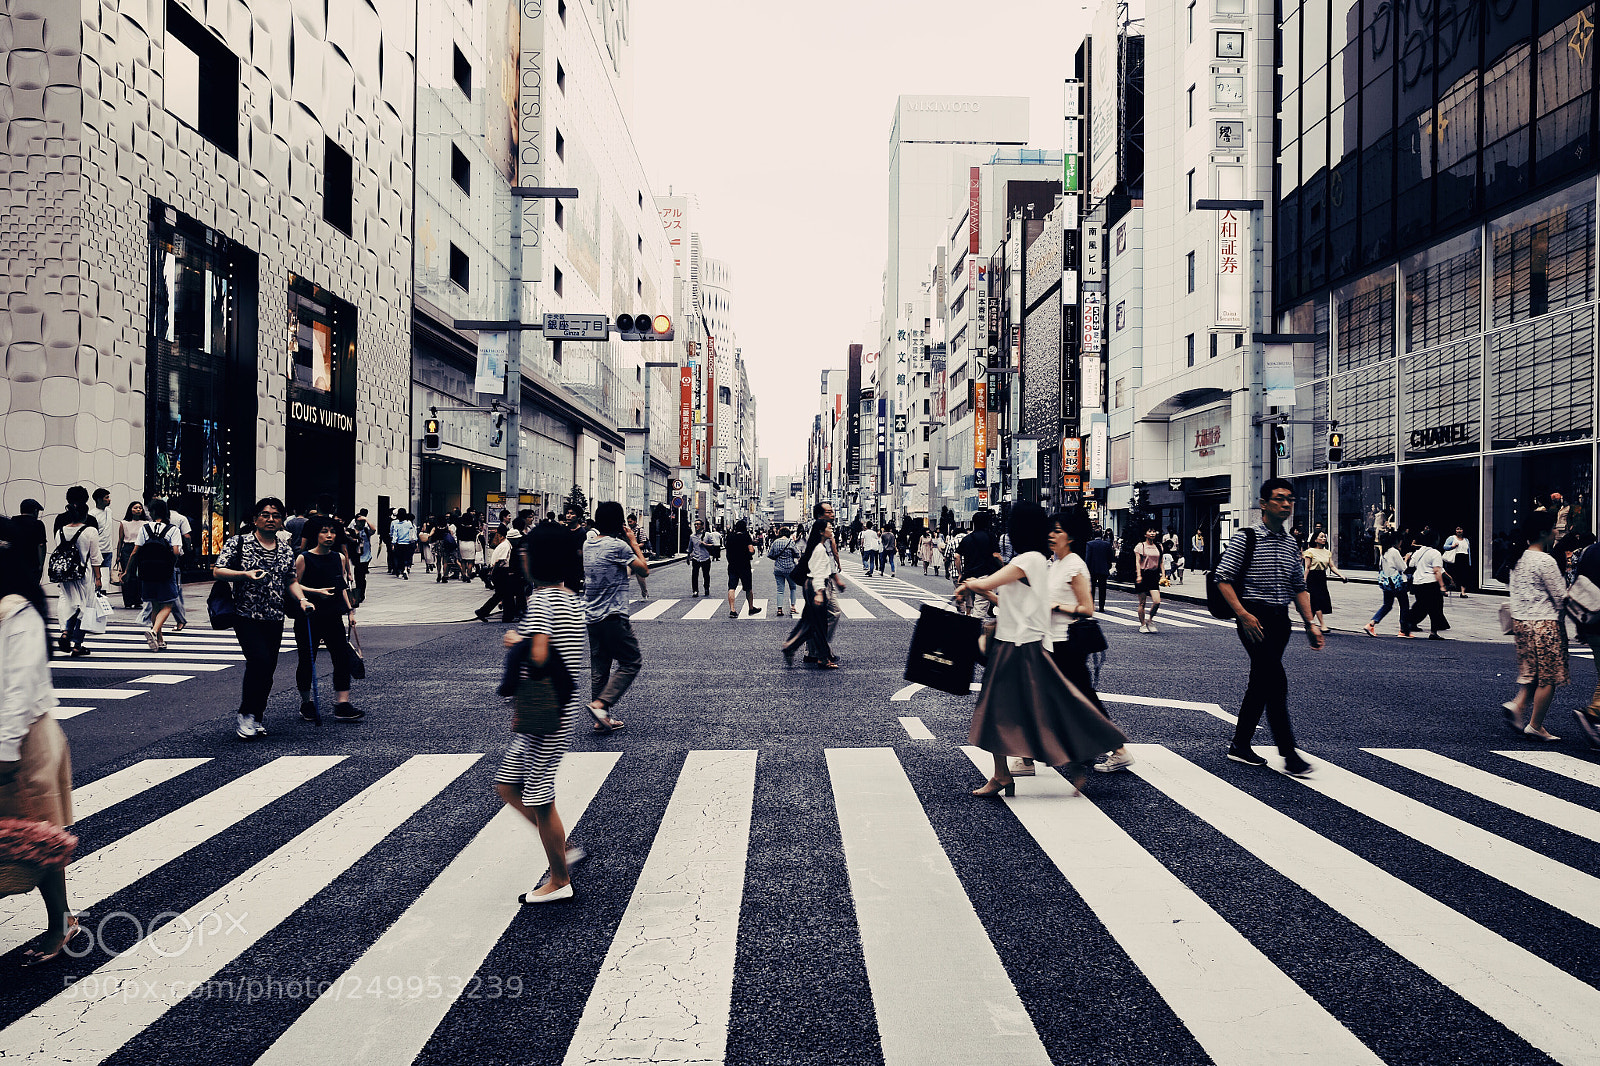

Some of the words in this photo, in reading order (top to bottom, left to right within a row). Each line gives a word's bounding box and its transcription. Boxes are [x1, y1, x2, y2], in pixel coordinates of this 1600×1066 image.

[906, 102, 981, 113] MIKIMOTO
[1088, 227, 1098, 275] 南風ビル
[547, 320, 603, 330] 銀座二丁目
[896, 329, 906, 386] 教文館
[291, 401, 317, 424] LOUIS
[319, 408, 353, 432] VUITTON
[1410, 423, 1471, 449] CHANEL
